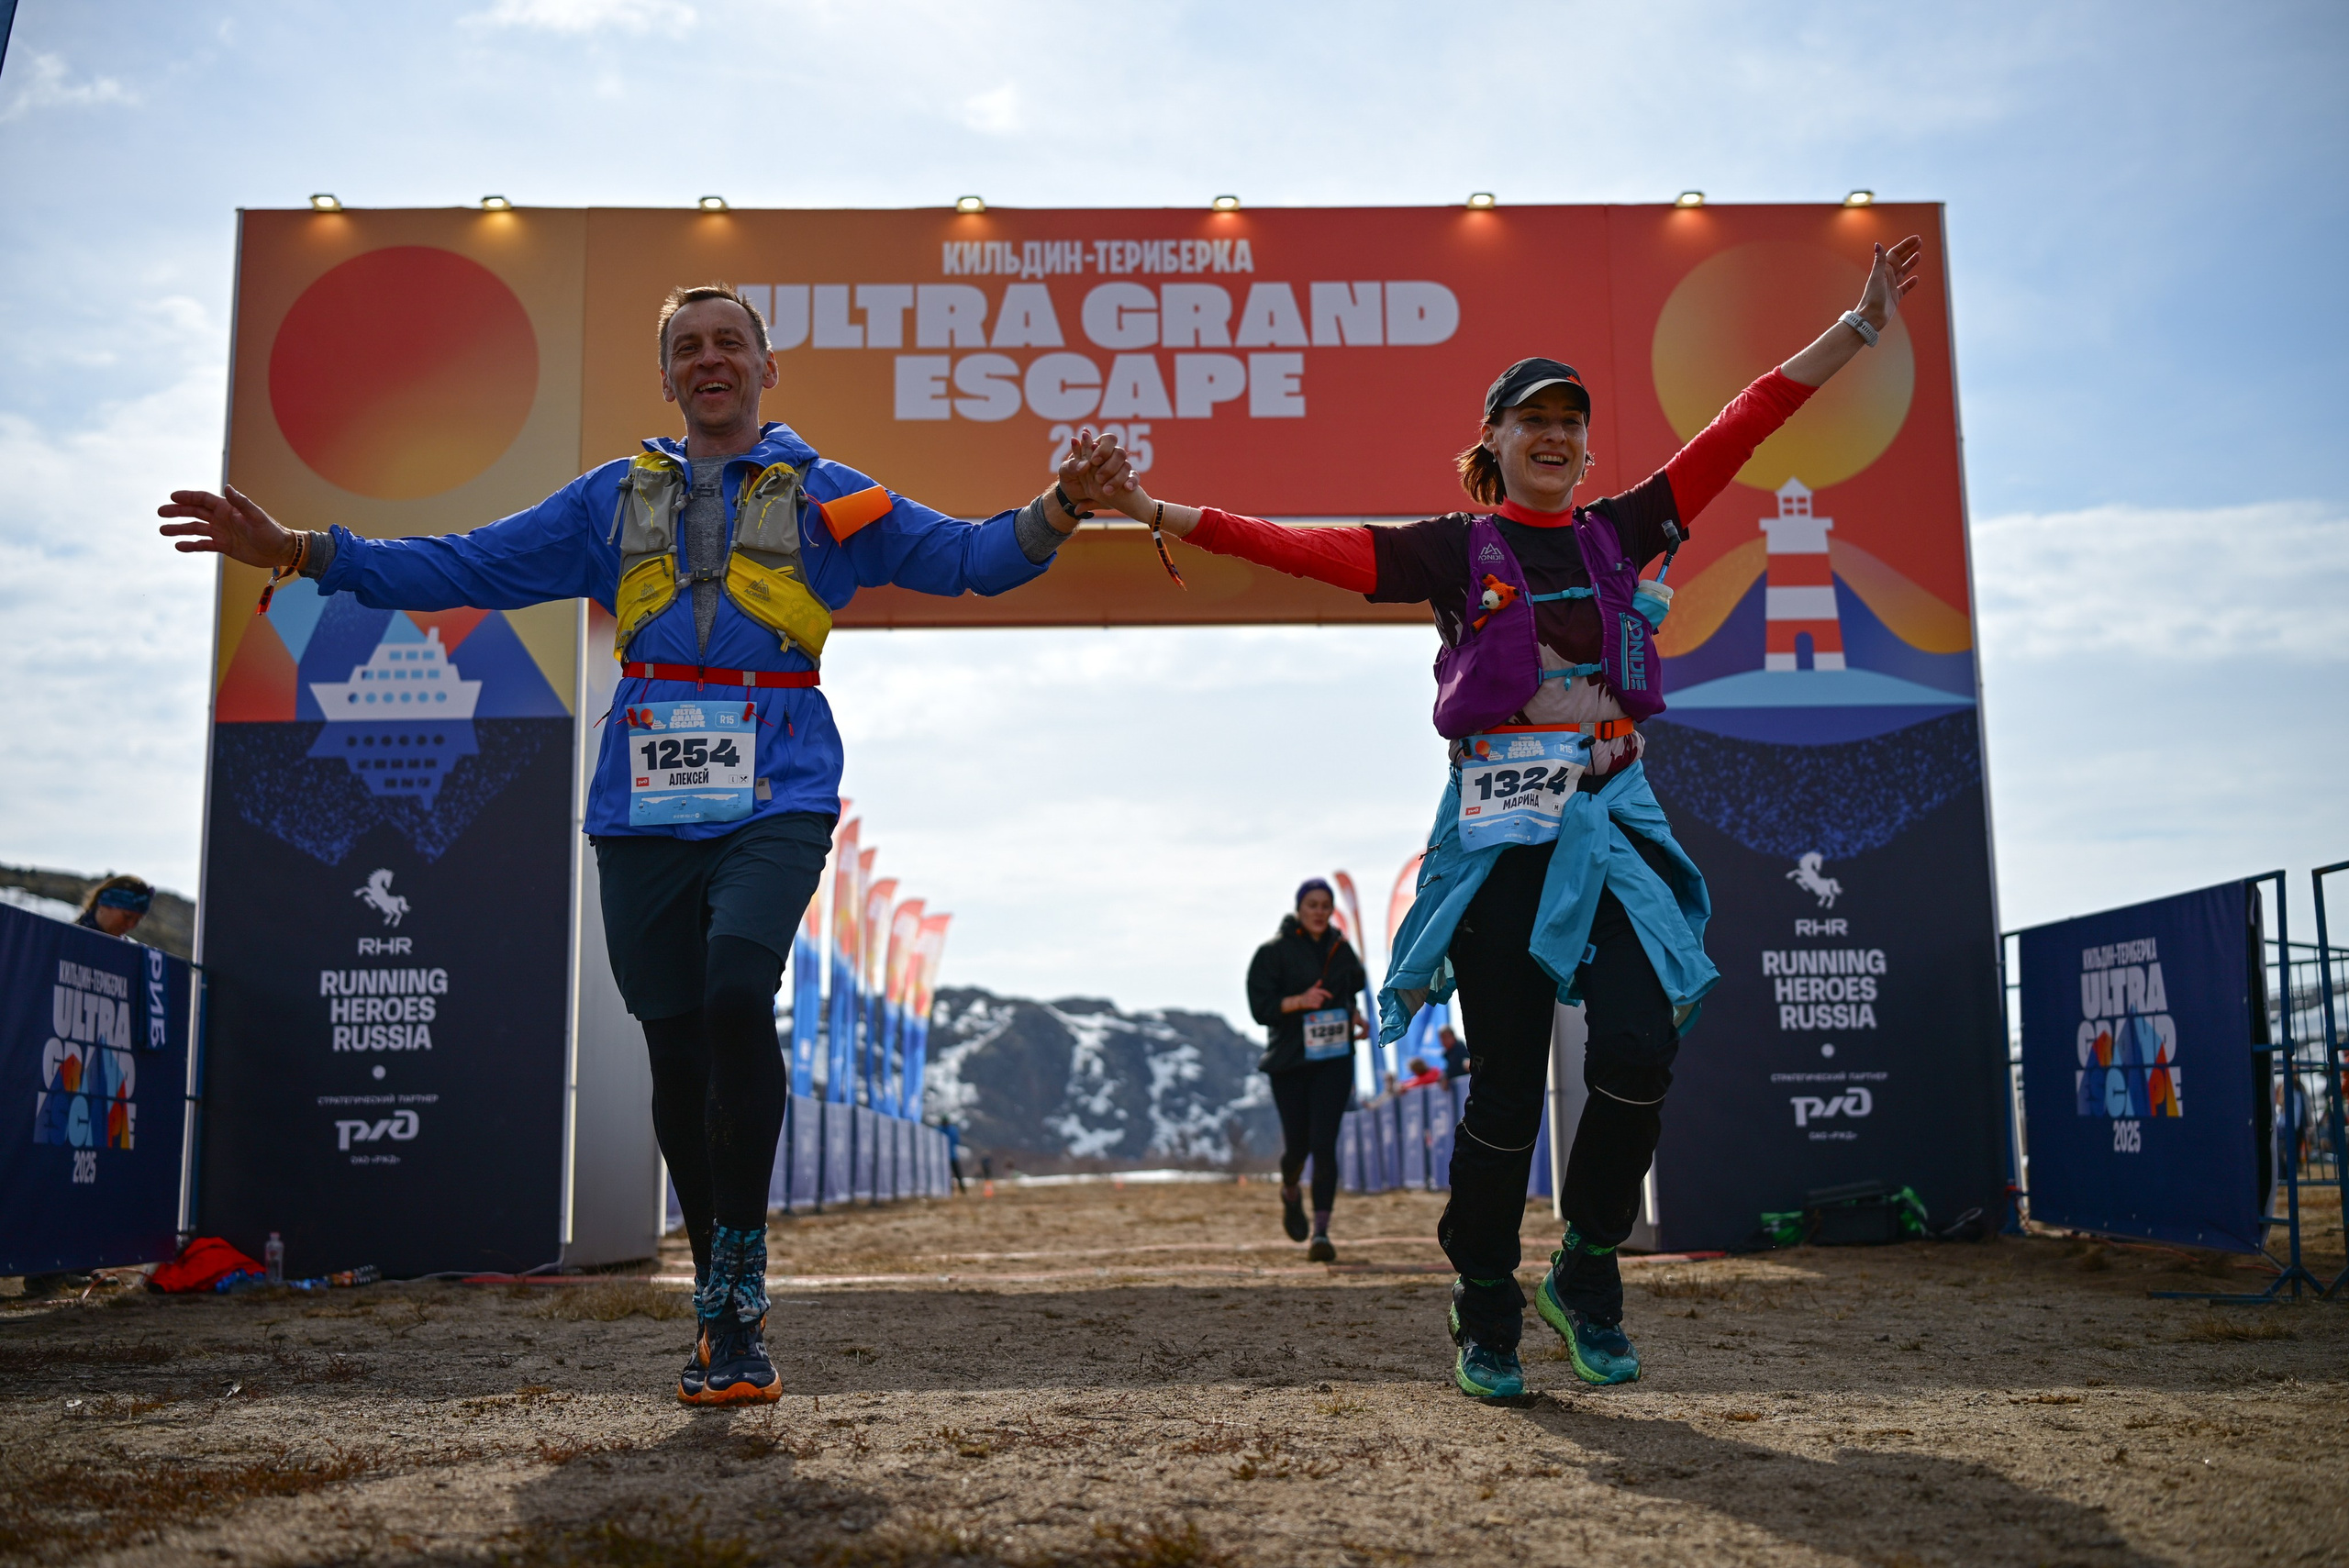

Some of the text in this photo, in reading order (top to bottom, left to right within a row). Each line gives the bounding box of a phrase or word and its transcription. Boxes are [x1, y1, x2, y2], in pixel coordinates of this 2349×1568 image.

[942, 239, 1254, 279] КИЛЬДИН-ТЕРИБЕРКА
[1081, 280, 1461, 350] GRAND
[894, 351, 1307, 422] ESCAPE
[669, 720, 706, 729] ESCAPE
[673, 707, 703, 716] ULTRA
[719, 715, 735, 725] R15
[641, 738, 740, 771] 1254
[1559, 743, 1573, 754] R15
[669, 768, 709, 786] АЛЕКСЕЙ
[1475, 766, 1570, 801] 1324
[1502, 793, 1540, 810] МАРИНА
[1794, 918, 1848, 937] RHR
[357, 937, 414, 956] RHR
[2082, 936, 2158, 971] КИЛЬДИН-ТЕРИБЕРКА
[1762, 949, 1887, 977] RUNNING
[319, 968, 449, 997] RUNNING
[1775, 976, 1878, 1004] HEROES
[2079, 962, 2168, 1021] ULTRA
[53, 984, 132, 1051] ULTRA
[329, 995, 437, 1025] HEROES
[1779, 1003, 1877, 1030] RUSSIA
[332, 1023, 433, 1052] RUSSIA
[2076, 1013, 2177, 1069] GRAND
[42, 1036, 137, 1101] GRAND
[2076, 1065, 2184, 1118] ESCAPE
[33, 1090, 138, 1151] ESCAPE
[2112, 1119, 2142, 1154] 2025
[72, 1150, 97, 1184] 2025
